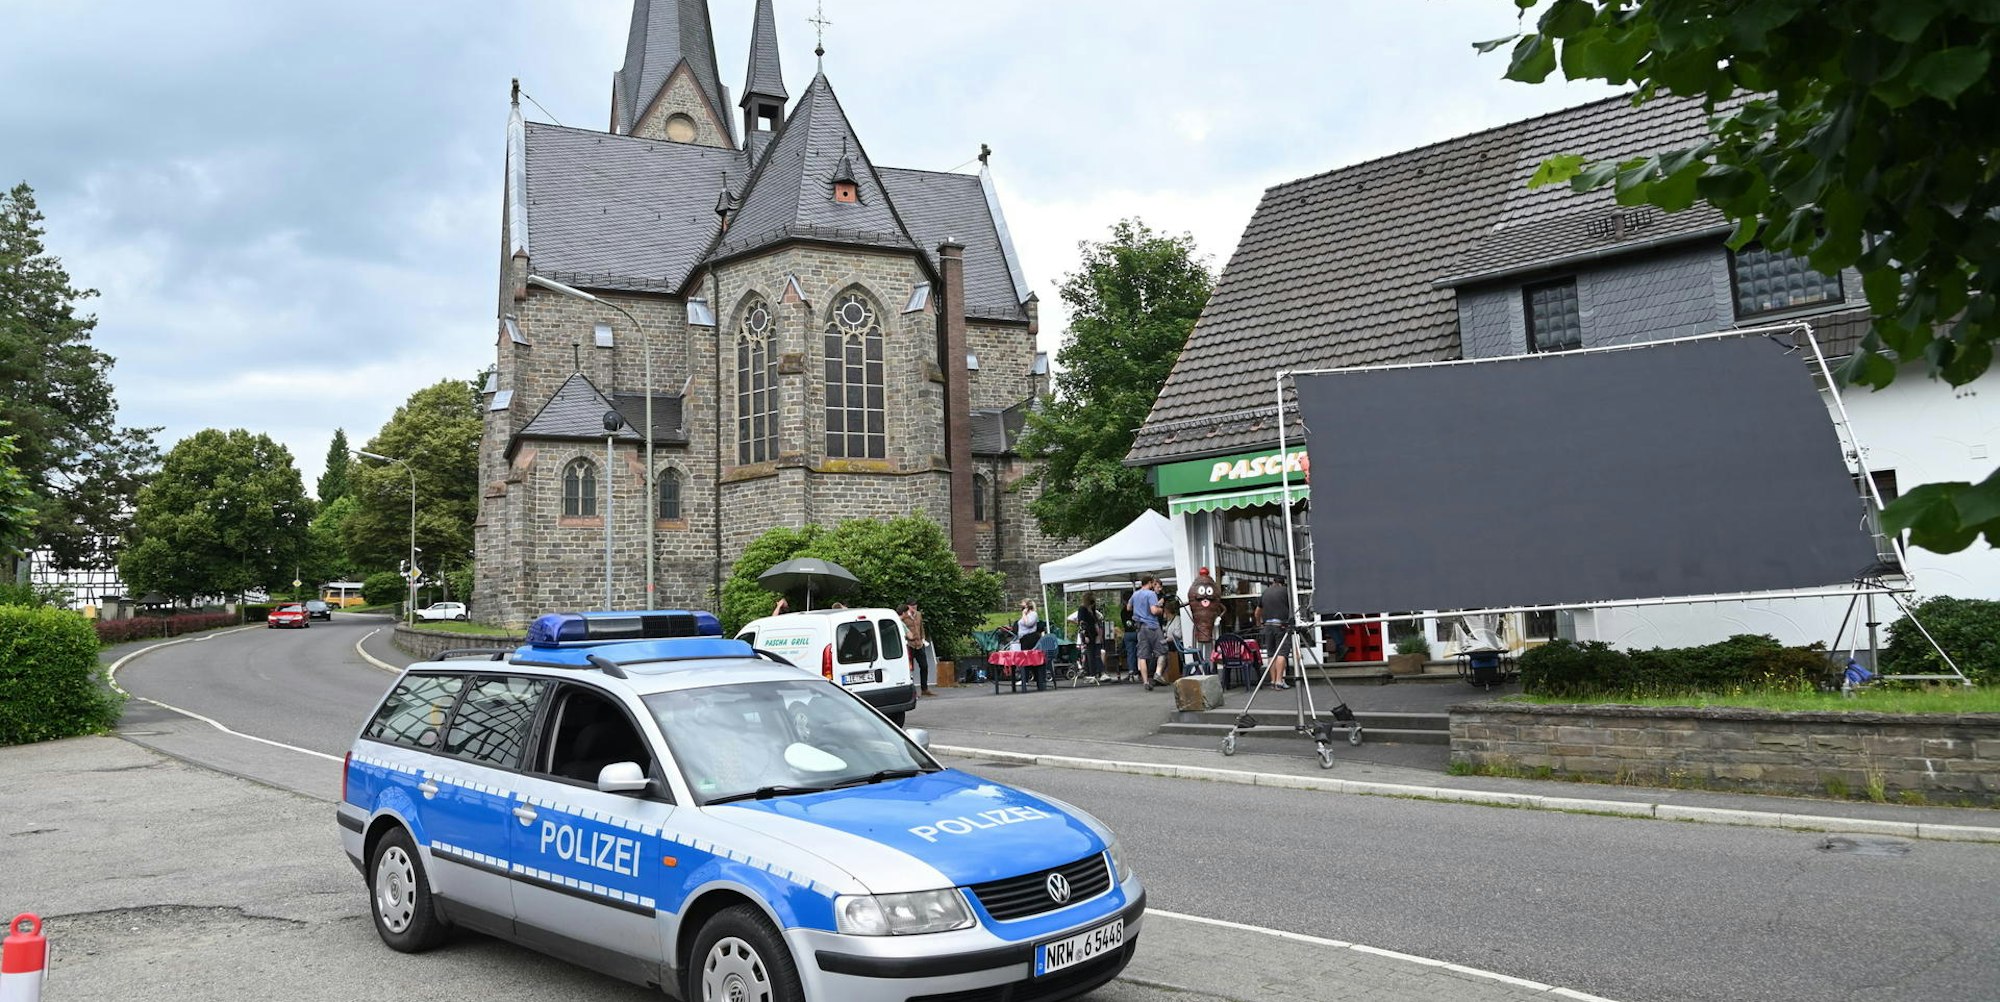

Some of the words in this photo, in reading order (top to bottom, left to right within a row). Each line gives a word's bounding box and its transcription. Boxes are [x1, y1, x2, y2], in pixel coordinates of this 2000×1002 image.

[765, 638, 788, 647] PASCHA
[791, 637, 809, 646] GRILL
[908, 806, 1052, 843] POLIZEI
[541, 820, 641, 878] POLIZEI
[1047, 940, 1075, 970] NRW
[1084, 934, 1092, 956] 6
[1095, 922, 1122, 952] 5448
